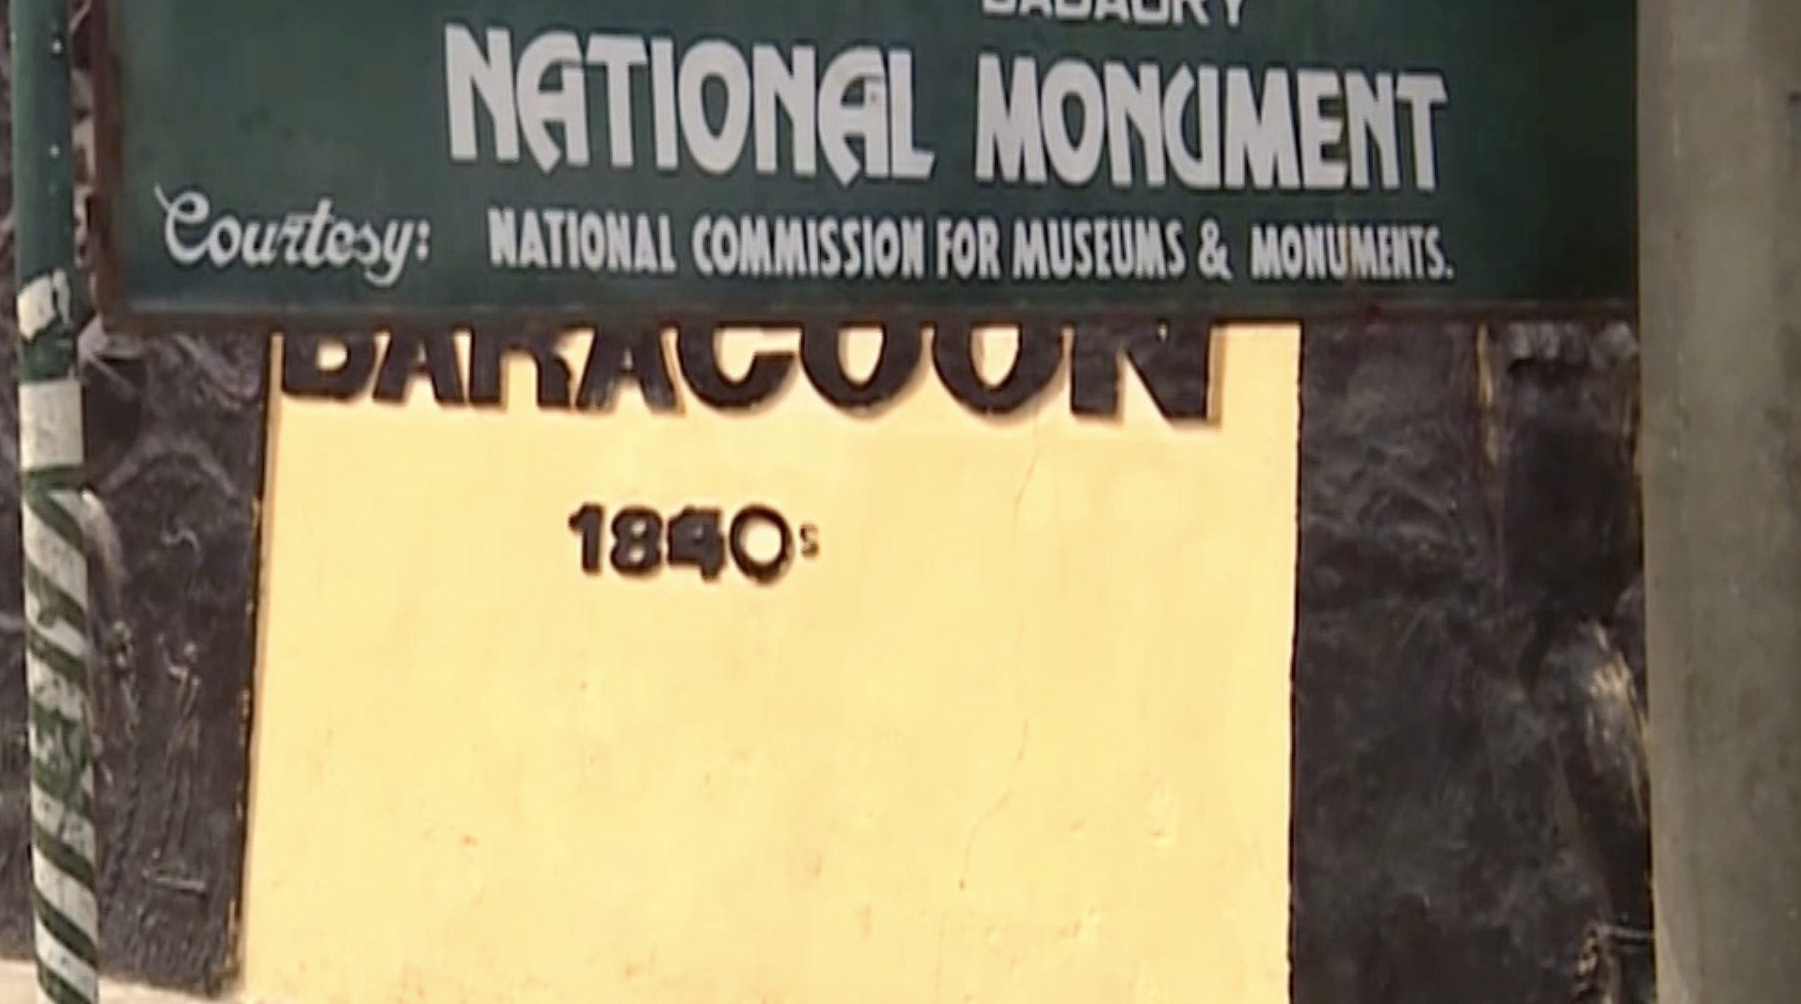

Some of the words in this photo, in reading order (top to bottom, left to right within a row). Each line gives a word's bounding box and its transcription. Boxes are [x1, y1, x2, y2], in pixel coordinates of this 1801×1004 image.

[445, 25, 934, 185] NATIONAL
[976, 54, 1446, 189] MONUMENT
[155, 186, 430, 285] Courtesy:
[487, 208, 676, 272] NATIONAL
[692, 215, 924, 276] COMMISSION
[937, 219, 1000, 276] FOR
[1013, 220, 1185, 277] MUSEUMS
[1198, 218, 1233, 279] &
[1252, 226, 1454, 280] MONUMENTS.
